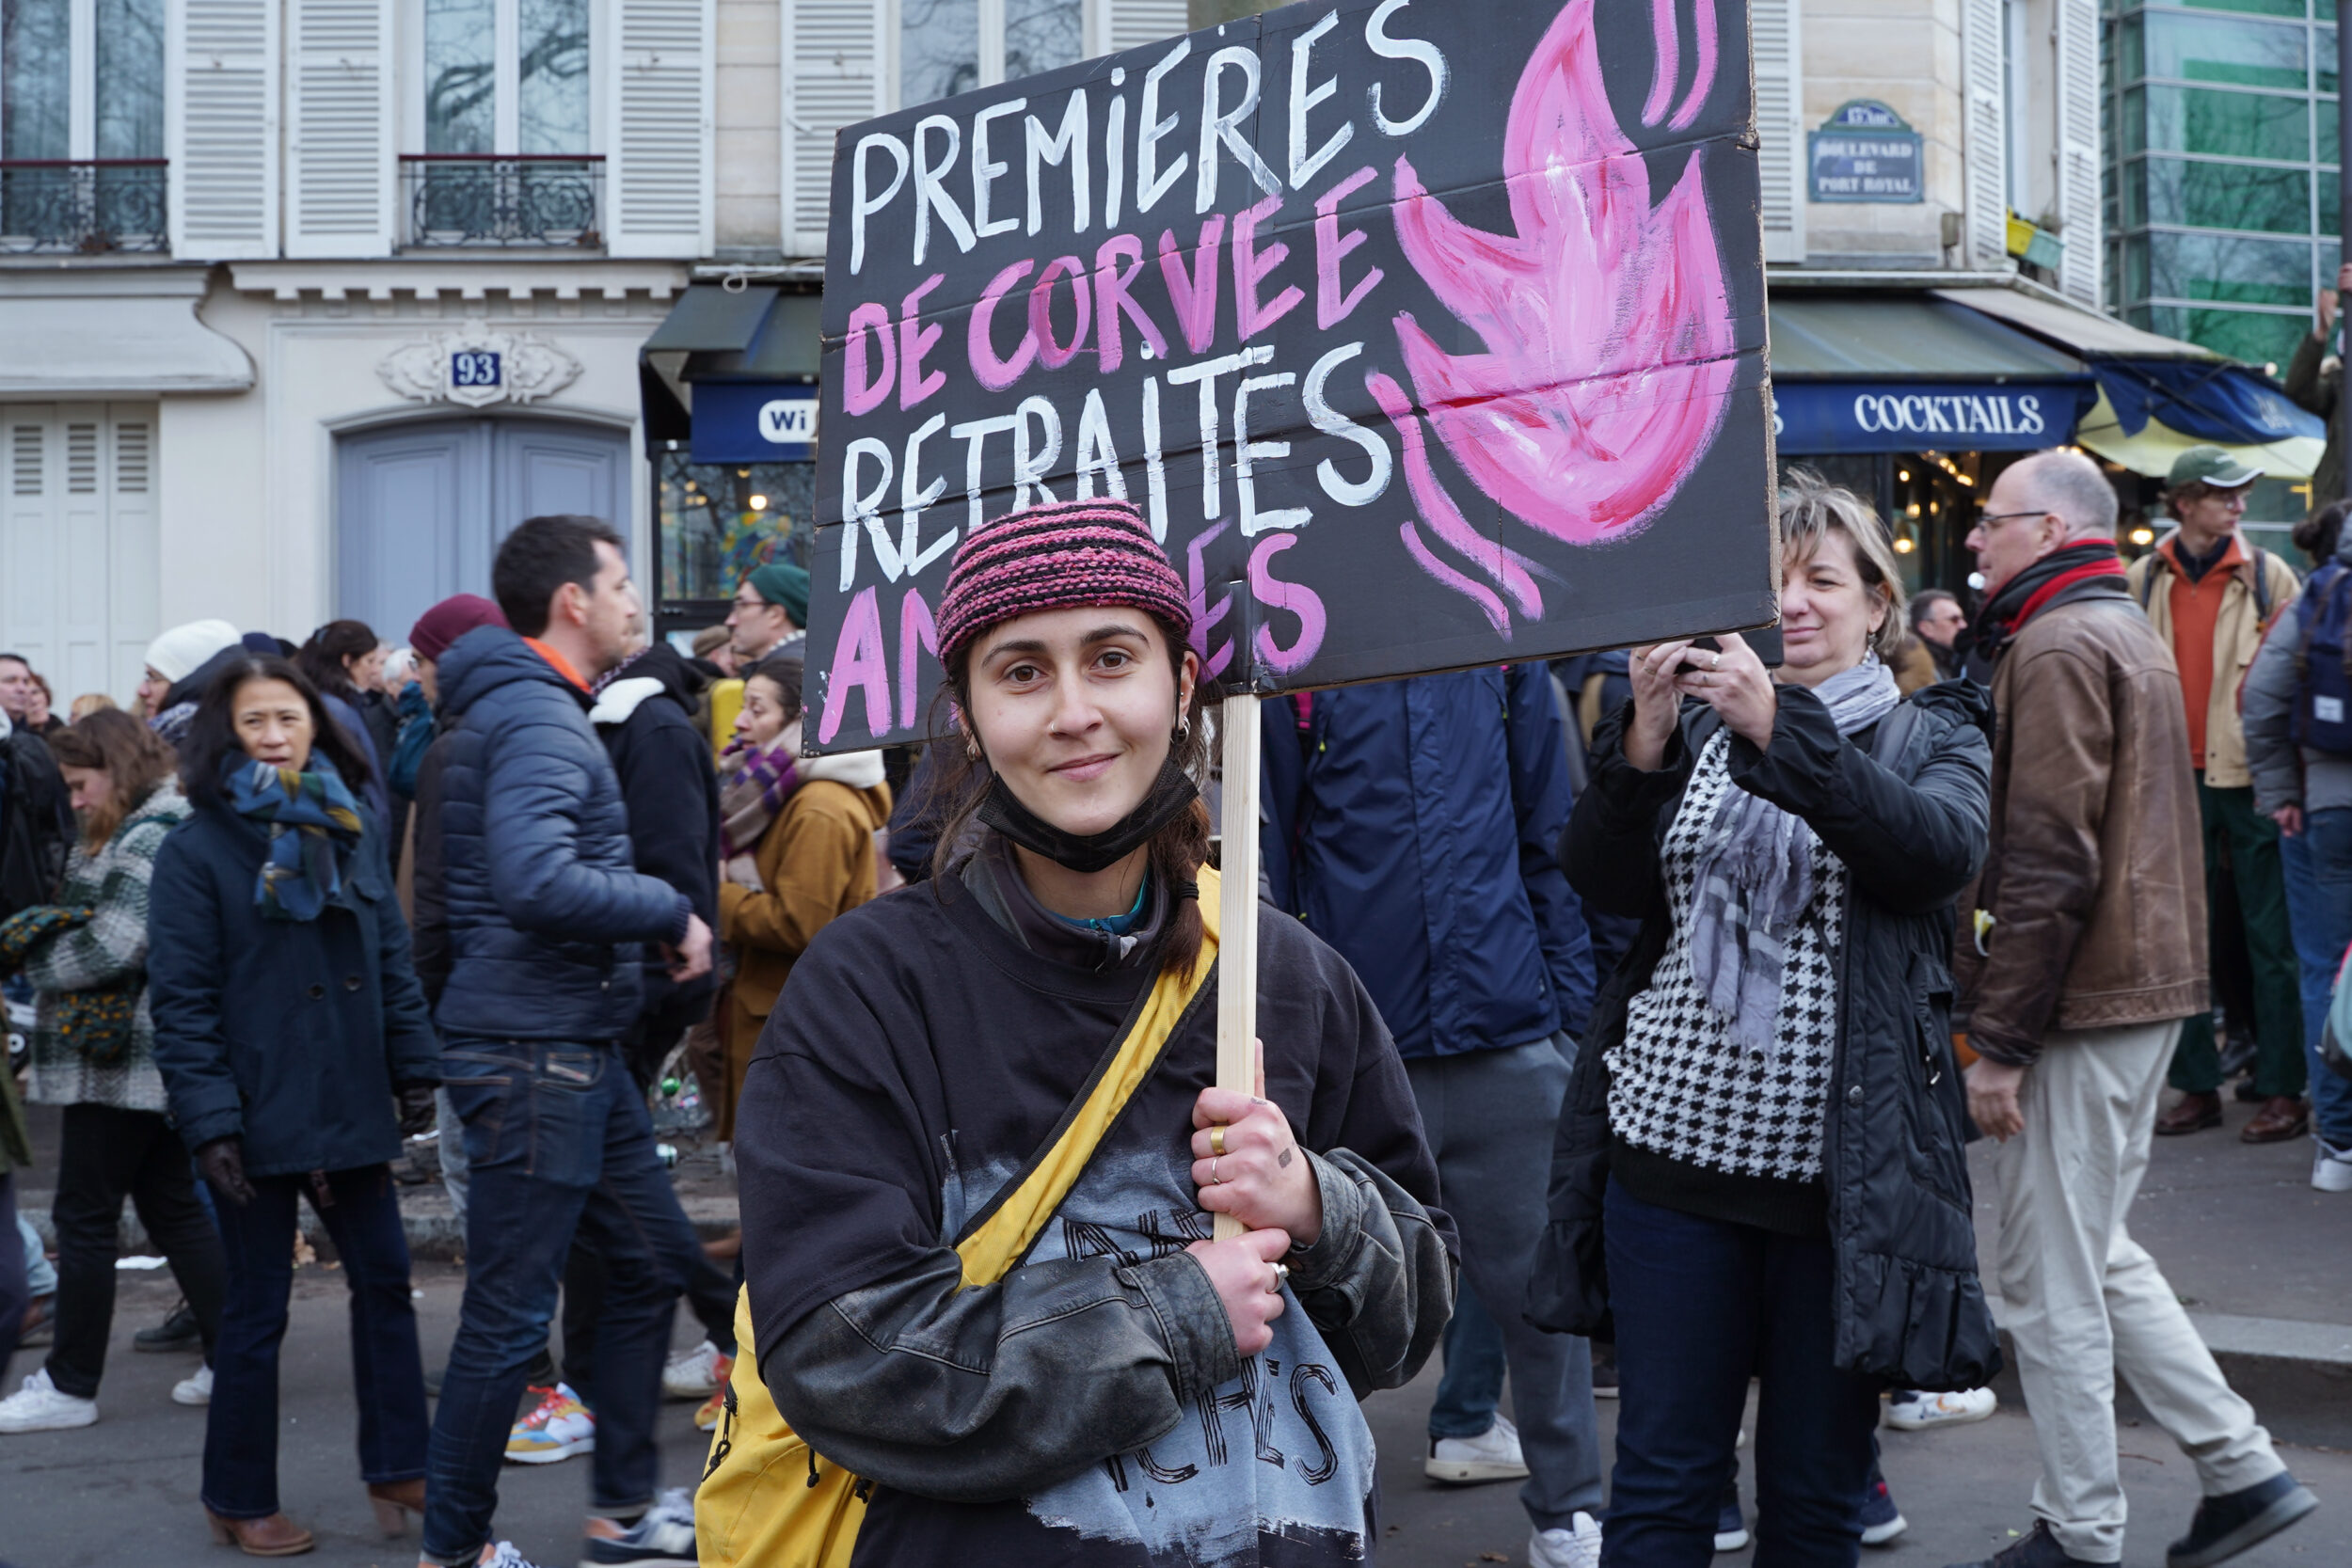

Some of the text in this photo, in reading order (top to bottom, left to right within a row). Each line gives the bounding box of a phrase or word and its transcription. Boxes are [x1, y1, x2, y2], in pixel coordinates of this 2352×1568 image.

[1817, 140, 1914, 158] BOULEVARD
[1853, 160, 1877, 175] DE
[1818, 177, 1914, 194] PORT ROYAL
[843, 166, 1384, 416] DE CORVEE
[456, 354, 496, 385] 93
[1854, 394, 2044, 435] COCKTAILS
